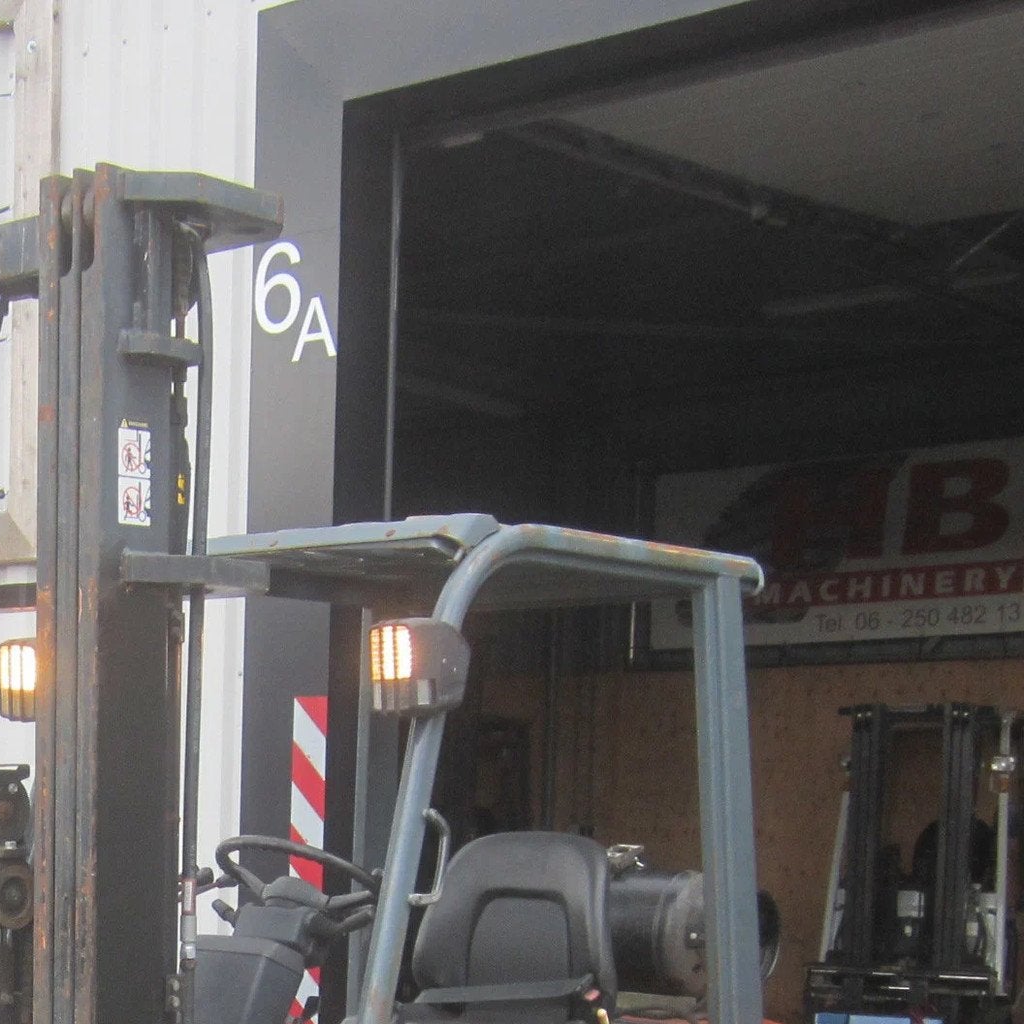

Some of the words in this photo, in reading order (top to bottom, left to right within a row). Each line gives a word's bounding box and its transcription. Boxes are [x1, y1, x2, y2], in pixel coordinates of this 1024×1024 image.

[255, 242, 337, 362] 6A
[772, 458, 1010, 571] HB
[755, 566, 1016, 605] MACHINERY
[855, 611, 881, 631] 06
[902, 606, 940, 628] 250
[947, 604, 987, 625] 482
